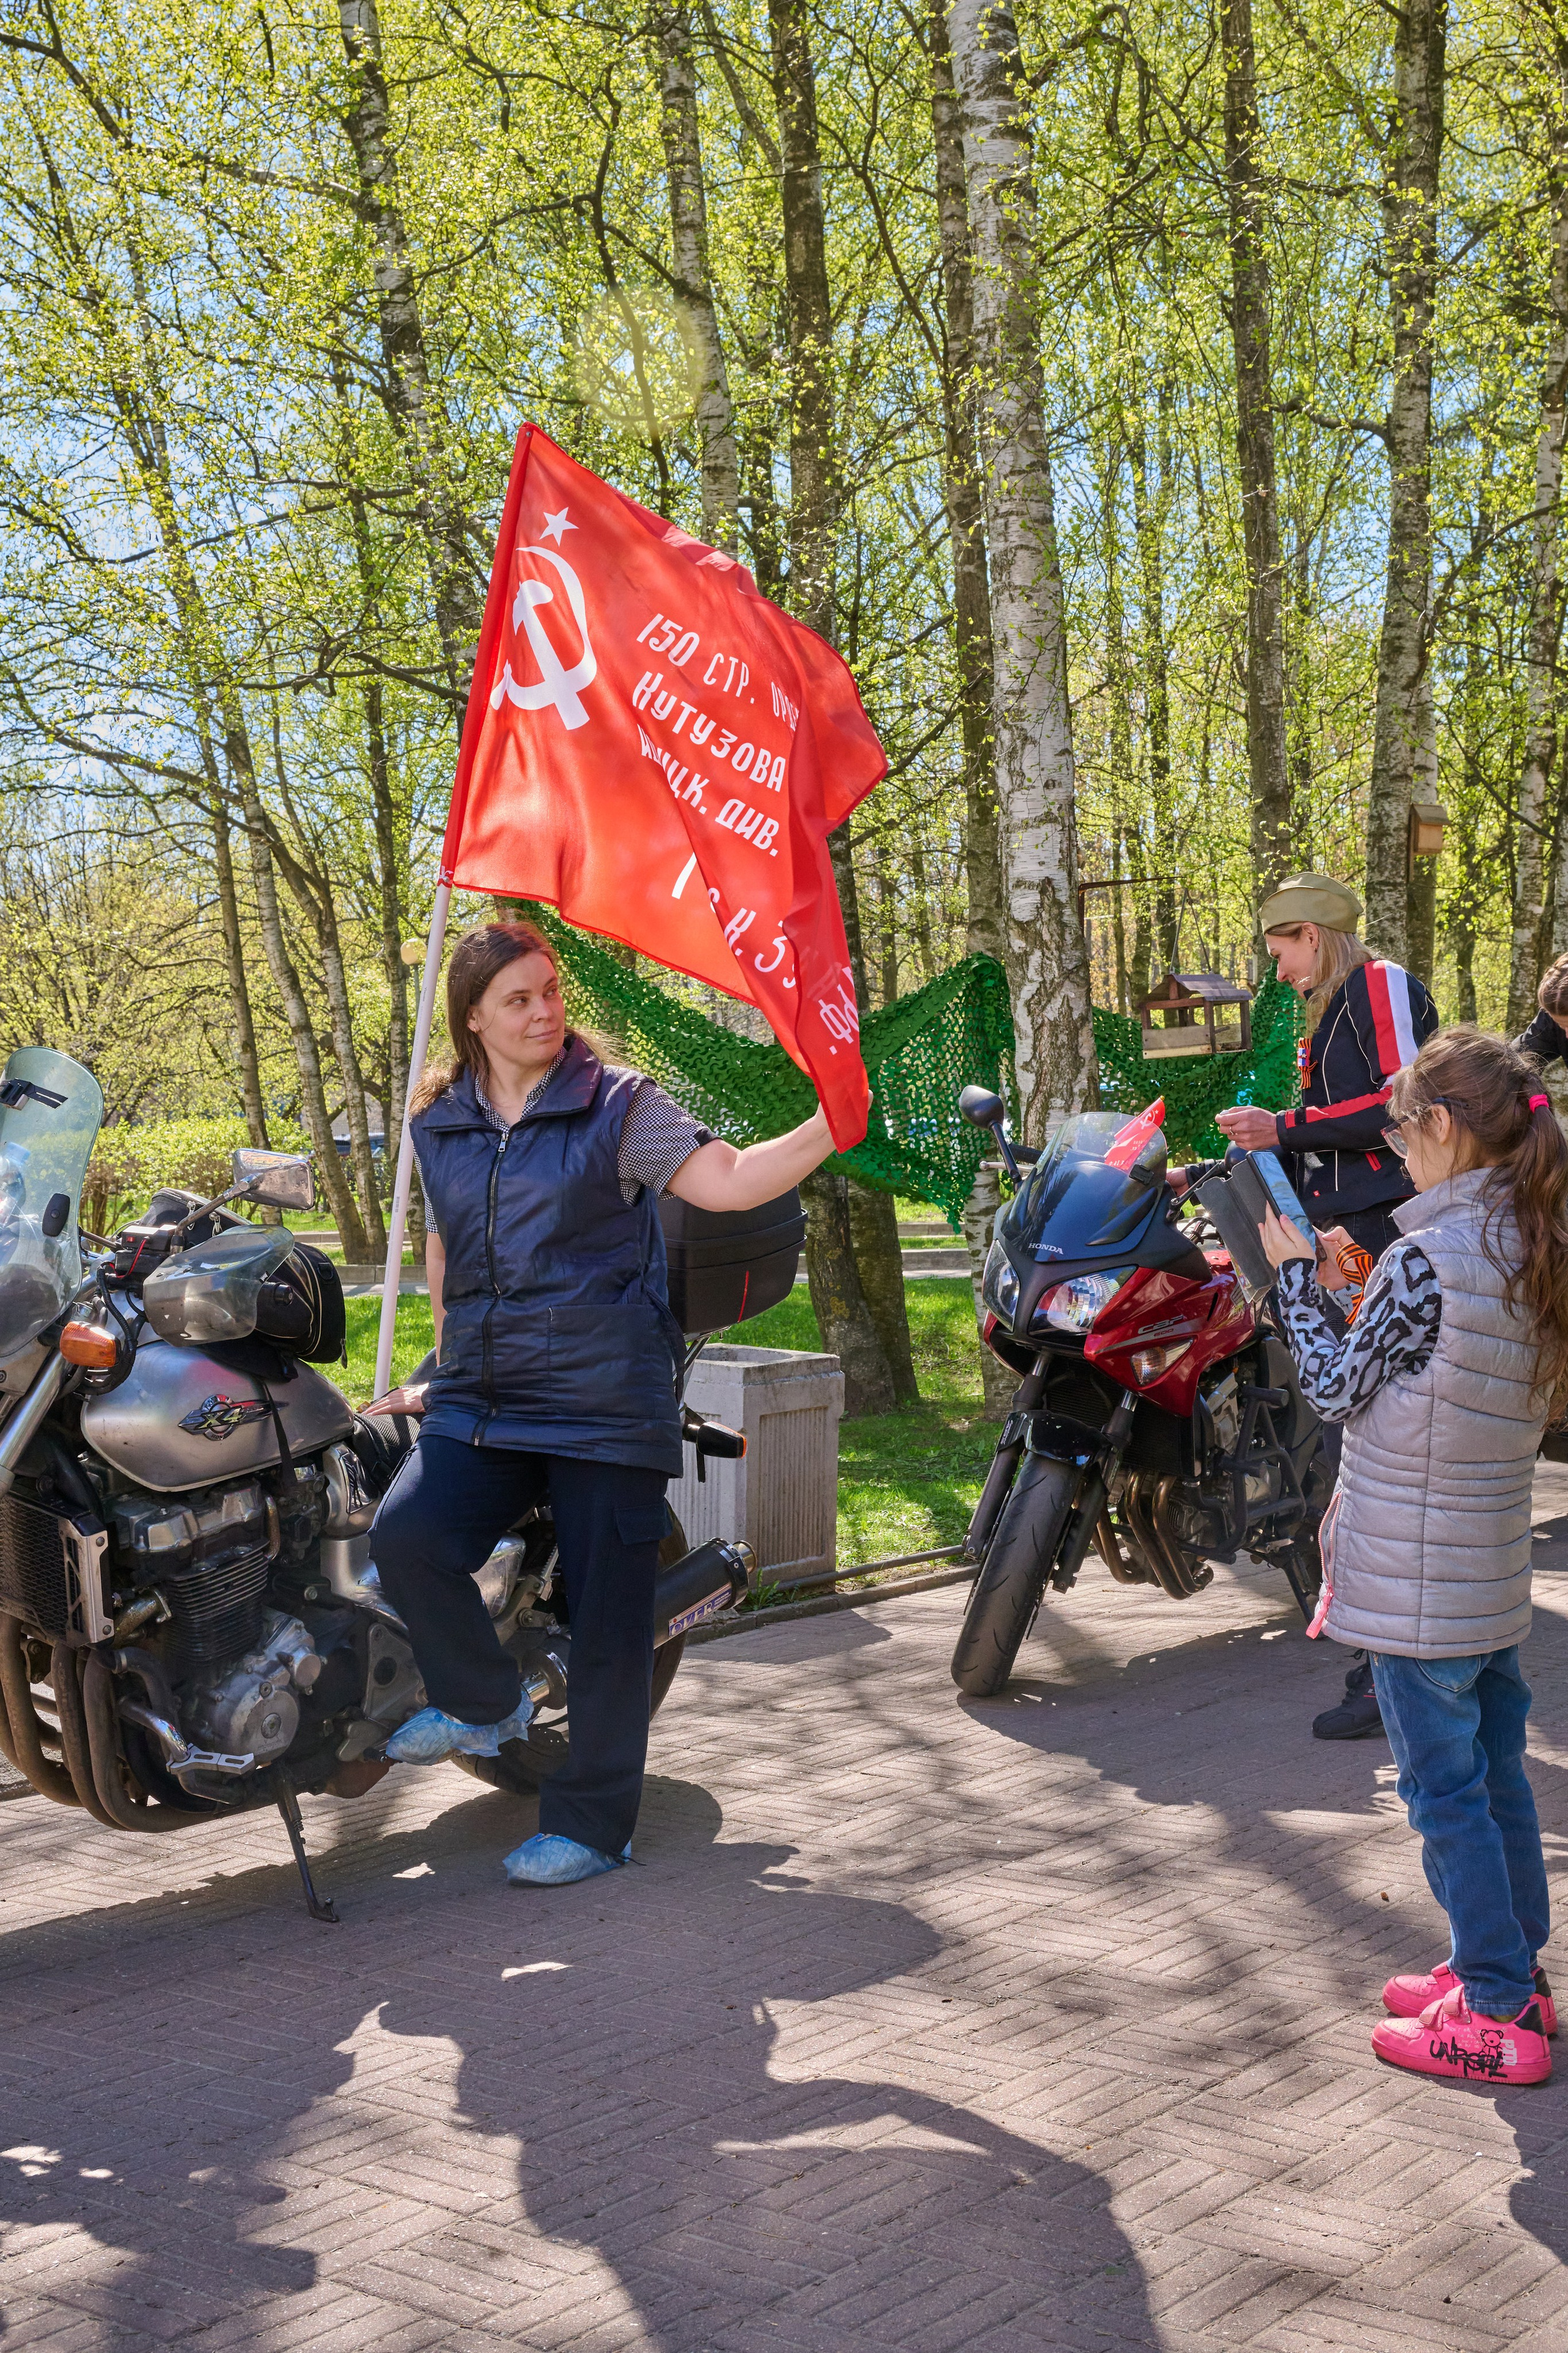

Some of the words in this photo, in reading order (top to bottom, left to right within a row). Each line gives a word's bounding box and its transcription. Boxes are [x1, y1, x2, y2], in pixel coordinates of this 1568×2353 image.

[636, 613, 700, 667] 150
[703, 652, 755, 704] СТР.
[714, 798, 779, 858] ДИВ.
[1028, 1242, 1064, 1255] HONDA
[1137, 1314, 1185, 1335] CBF
[1153, 1328, 1174, 1337] 600
[198, 1407, 243, 1429] X4
